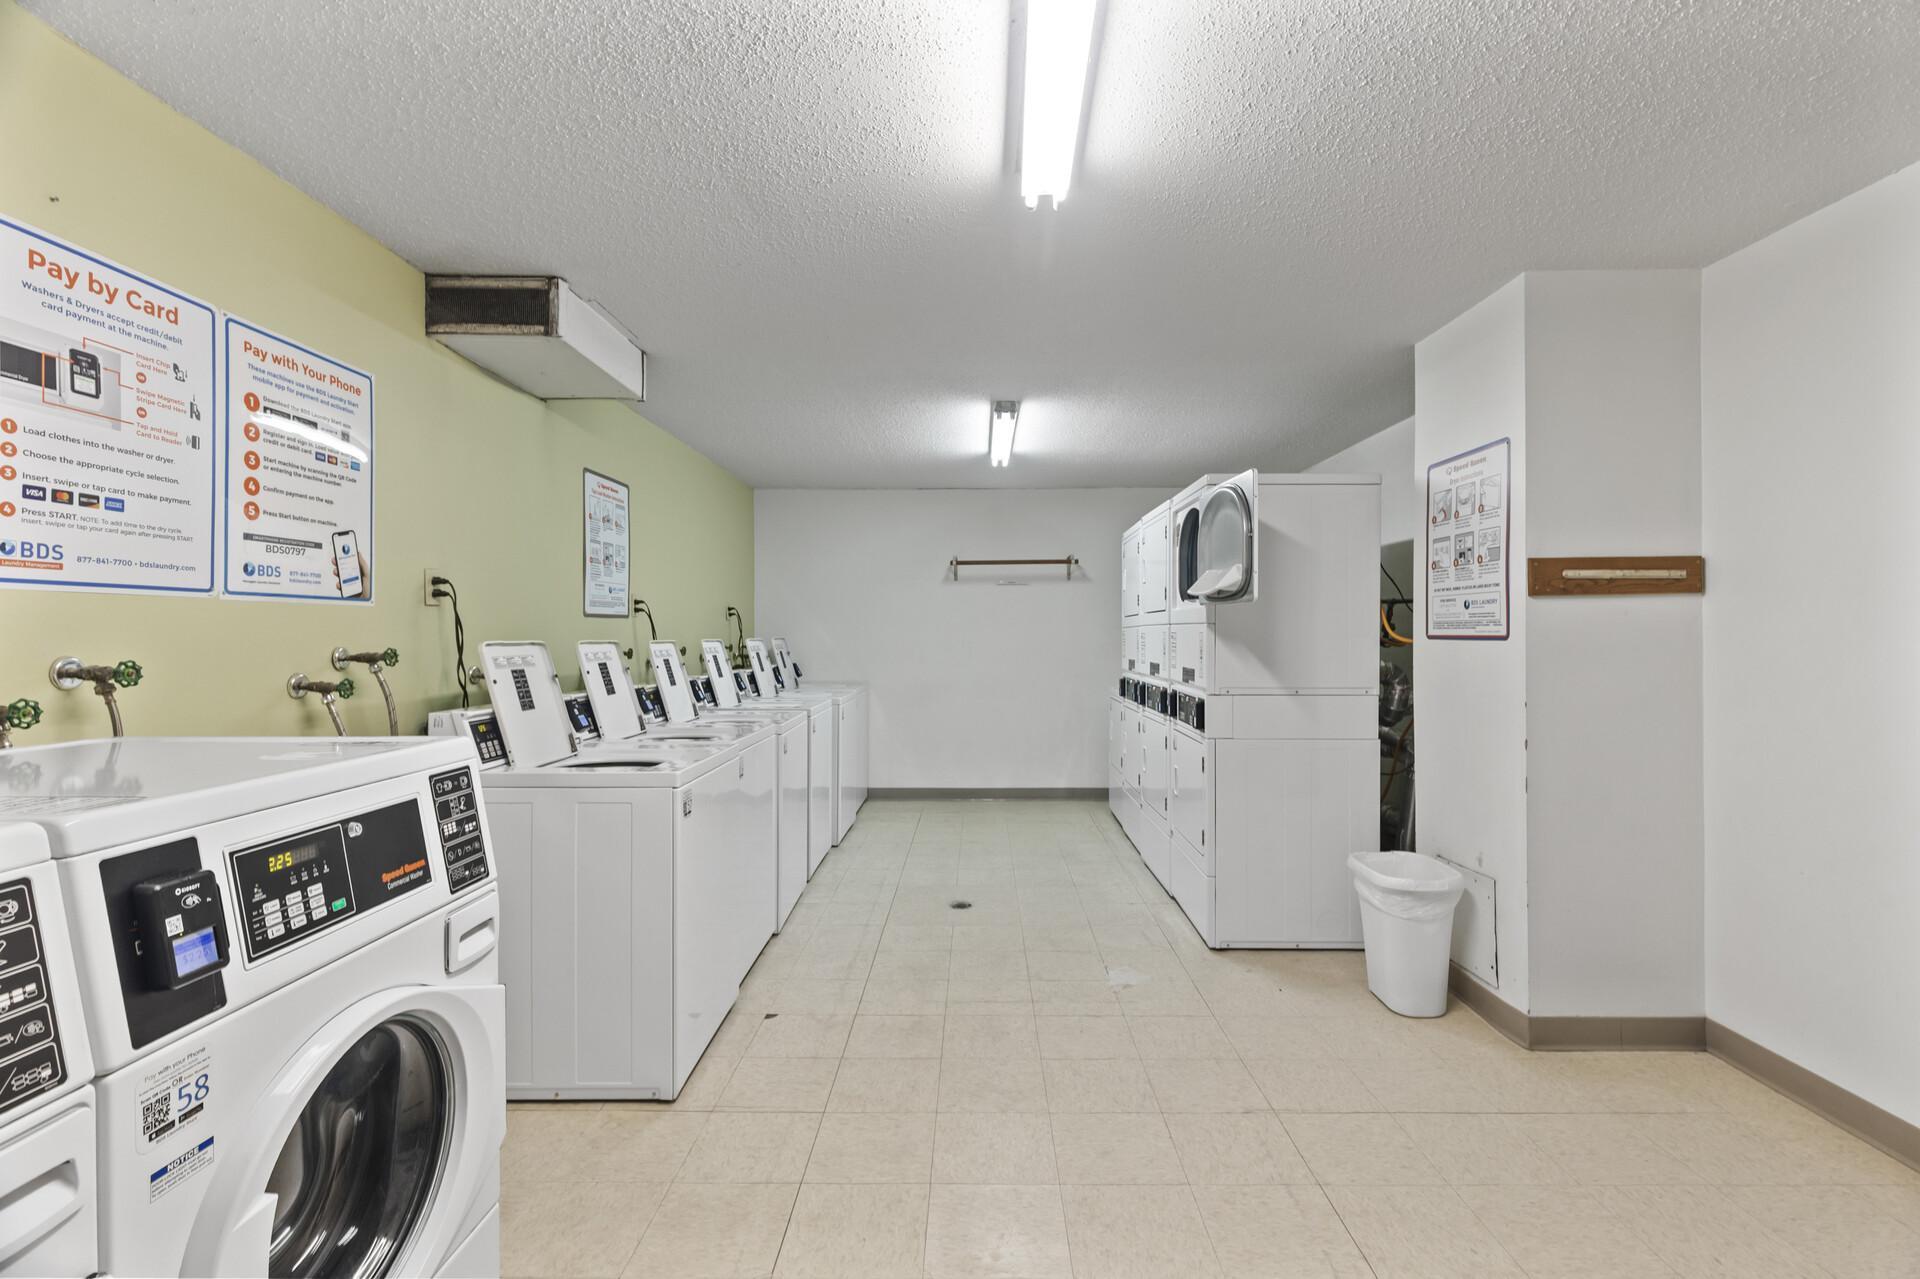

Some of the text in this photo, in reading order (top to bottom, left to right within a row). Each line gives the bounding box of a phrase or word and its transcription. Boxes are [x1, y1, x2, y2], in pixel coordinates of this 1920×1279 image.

[28, 248, 180, 326] Pay by Card
[21, 280, 183, 346] Washers & Dryers accept credit/debit
[41, 301, 168, 351] card payment at the machine.
[136, 353, 170, 369] Insert Chip
[136, 360, 167, 375] Card Here
[243, 341, 362, 396] Pay with Your Phone
[248, 362, 266, 374] These
[267, 371, 294, 385] machines
[306, 384, 315, 392] the
[316, 388, 326, 397] BDS
[327, 392, 346, 404] Laundry
[252, 375, 273, 386] mobile
[274, 383, 285, 391] app
[296, 390, 319, 402] payment
[136, 387, 185, 406] Swipe Magnetic
[136, 395, 155, 406] Stripe
[157, 402, 172, 410] Card
[249, 396, 254, 407] 1
[136, 422, 148, 431] Tap
[163, 429, 178, 437] Hold
[136, 430, 151, 439] Card
[248, 427, 256, 436] 2
[6, 420, 11, 430] 1
[23, 426, 46, 437] Load
[48, 432, 81, 444] clothes
[83, 438, 100, 448] into
[102, 443, 115, 452] the
[117, 447, 144, 458] washer
[155, 455, 176, 464] dryer.
[263, 438, 279, 446] credit
[287, 443, 300, 451] debit
[4, 444, 180, 485] 2 Choose the appropriate cycle selection.
[248, 455, 256, 465] 3
[263, 456, 276, 464] Start
[278, 460, 299, 469] machine
[270, 466, 292, 476] entering
[4, 468, 12, 476] 3
[22, 472, 51, 484] Insert,
[53, 478, 79, 488] swipe
[92, 484, 106, 493] tap
[108, 487, 126, 495] card
[137, 492, 158, 500] make
[160, 496, 191, 506] payment.
[26, 488, 43, 497] VISA
[249, 481, 256, 491] 4
[263, 486, 285, 495] Confirm
[286, 490, 308, 500] payment
[3, 504, 11, 513] 4
[22, 508, 46, 517] Press
[49, 511, 78, 521] START.
[248, 505, 255, 515] 5
[263, 510, 278, 518] Press
[152, 533, 175, 541] pressing
[20, 541, 64, 560] BDS
[266, 544, 306, 556] BDS0797
[76, 556, 196, 572] 877-841-7700 bdslaundry.com
[257, 564, 281, 577] BDS
[268, 852, 292, 872] 2.25
[382, 866, 404, 883] Speed
[158, 1064, 171, 1075] with
[172, 1058, 186, 1069] your
[186, 1047, 206, 1059] Phone
[172, 1076, 183, 1087] OR
[177, 1073, 209, 1112] 58
[168, 1146, 199, 1172] NOTICE
